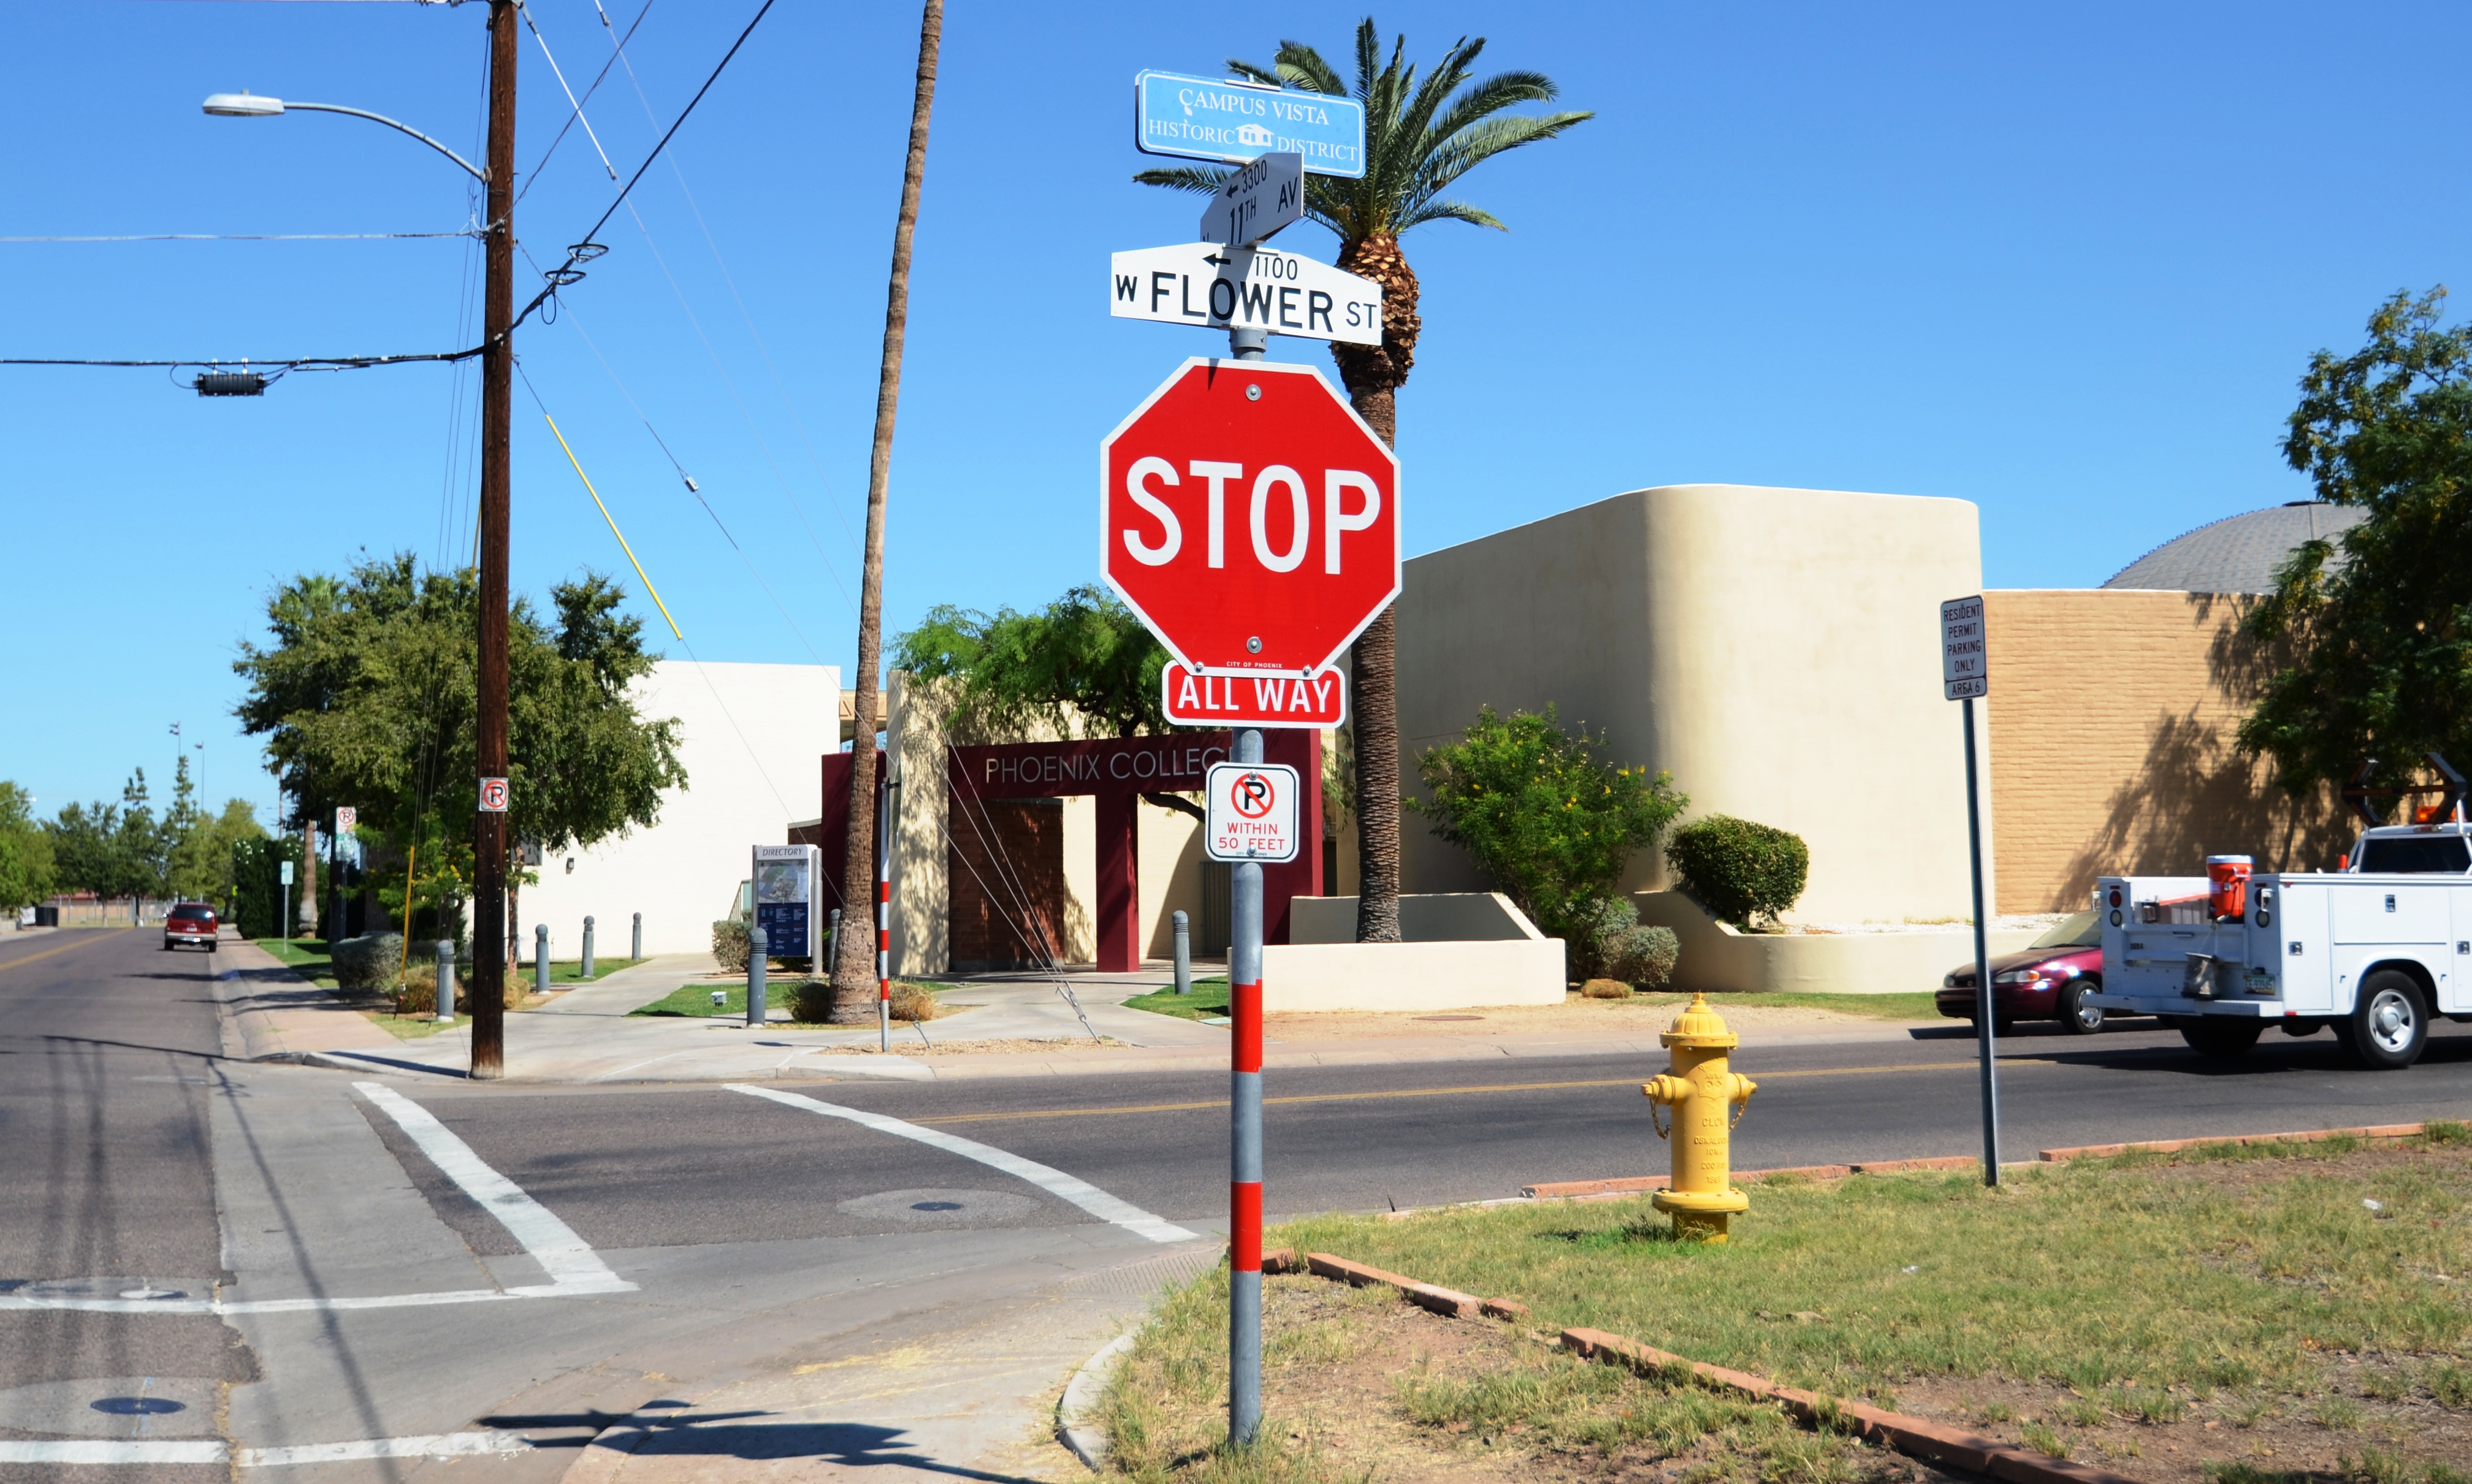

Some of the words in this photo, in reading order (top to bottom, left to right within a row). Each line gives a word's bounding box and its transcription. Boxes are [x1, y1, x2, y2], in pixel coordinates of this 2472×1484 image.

[1178, 88, 1266, 116] CAMPUS
[1272, 101, 1329, 126] VISTA
[1148, 119, 1235, 145] HISTORIC
[1277, 137, 1358, 161] DISTRICT
[1242, 159, 1267, 194] 3300
[1230, 196, 1256, 245] 11TH
[1278, 177, 1298, 213] AV
[1255, 256, 1298, 280] 1100
[1115, 274, 1138, 302] W
[1151, 270, 1333, 333] FLOWER
[1346, 301, 1378, 329] ST
[1123, 456, 1381, 575] STOP
[1944, 604, 1980, 622] RESIDENT
[1948, 623, 1977, 639] PERMIT
[1947, 640, 1980, 656] PARKING
[1955, 659, 1975, 673] ONLY
[1177, 675, 1239, 710] ALL
[1254, 678, 1332, 713] WAY
[1952, 682, 1973, 696] AREA
[1975, 681, 1980, 693] 6
[986, 754, 1101, 784] PHOENIX
[1227, 822, 1278, 835] WITHIN
[763, 848, 803, 856] DIRECTORY
[1219, 837, 1238, 849] 50
[1248, 838, 1285, 850] FEET
